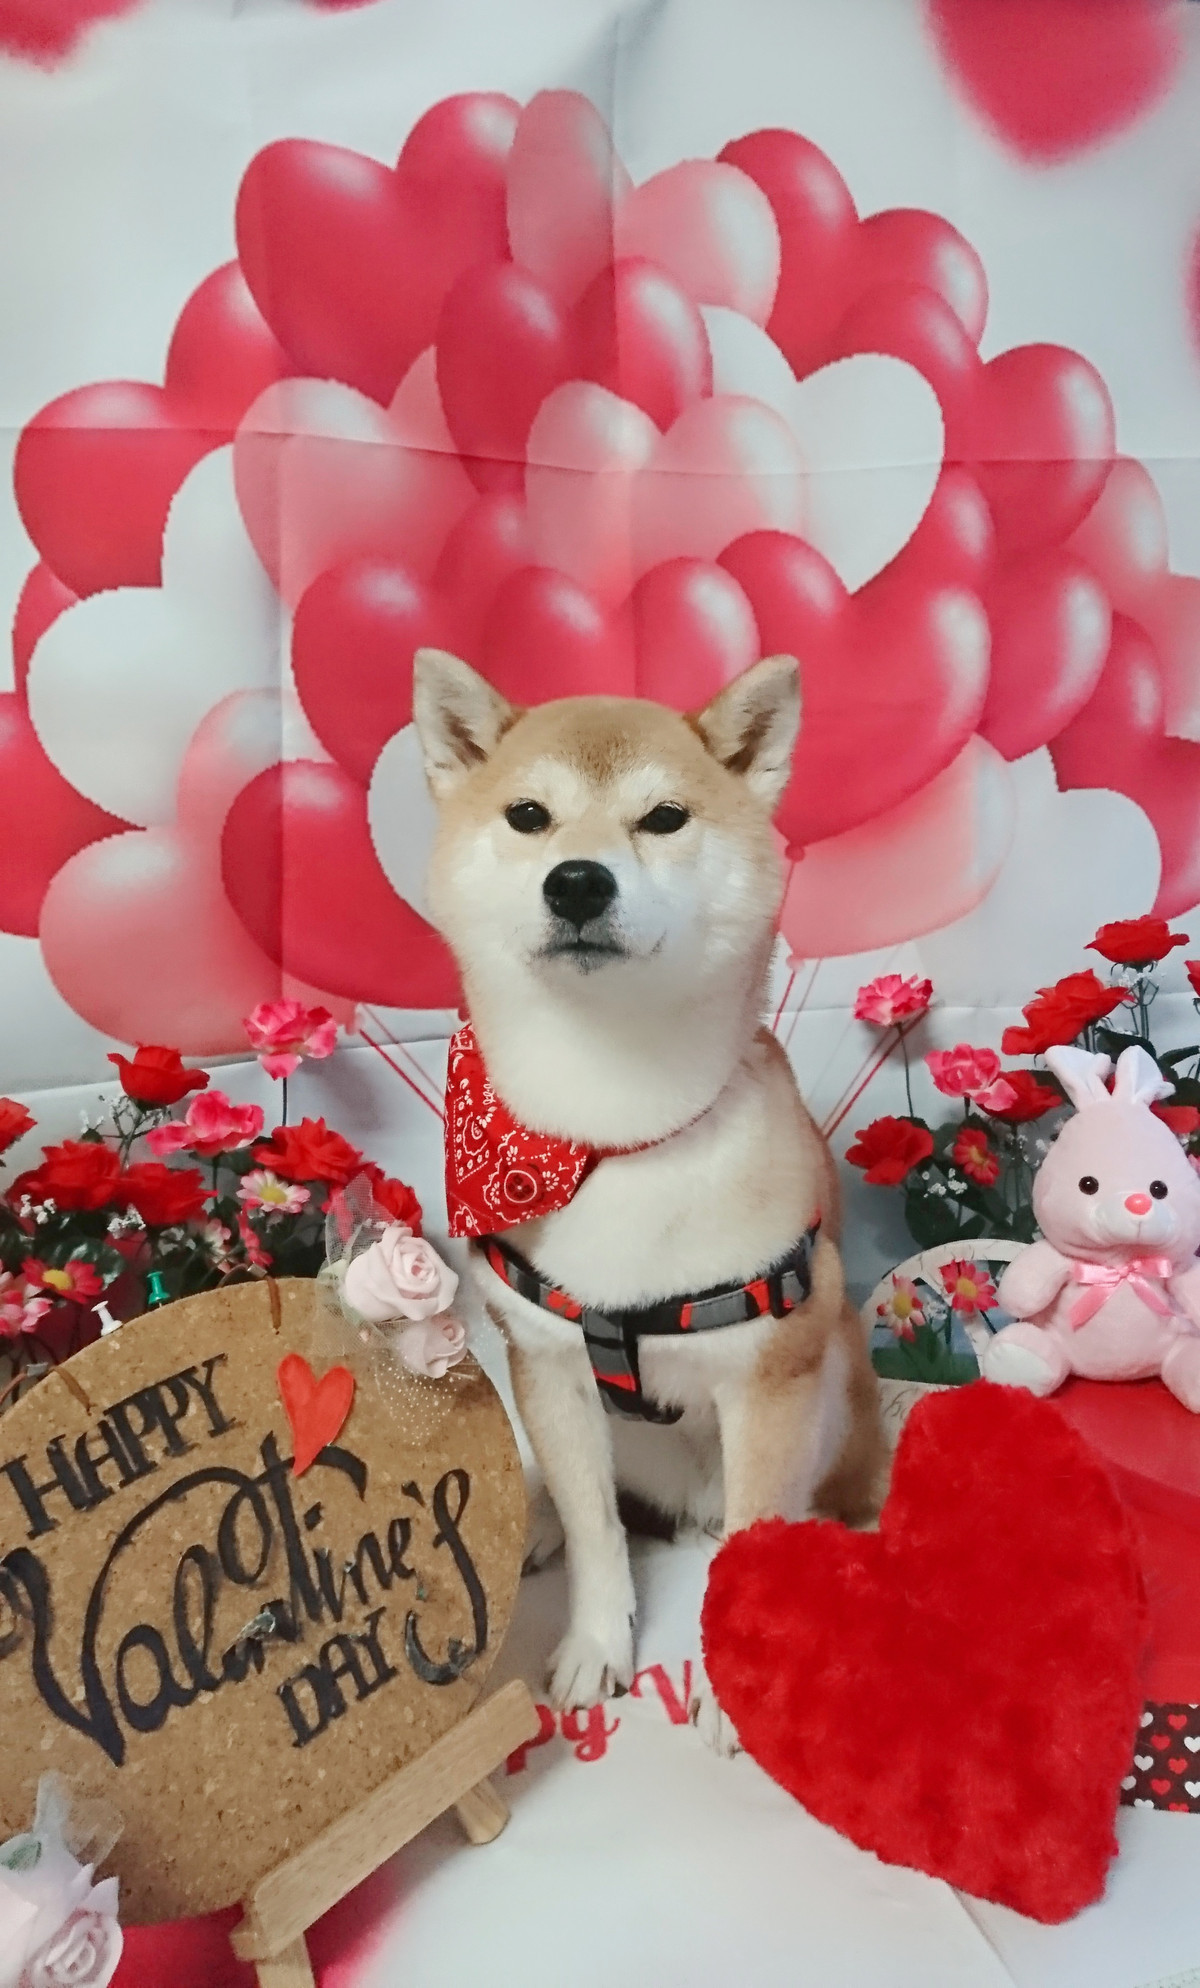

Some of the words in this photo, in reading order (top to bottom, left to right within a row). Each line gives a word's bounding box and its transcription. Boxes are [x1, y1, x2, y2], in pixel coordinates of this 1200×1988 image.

[0, 1352, 242, 1540] HAPPY
[276, 1606, 400, 1749] DAY
[629, 1659, 692, 1726] V
